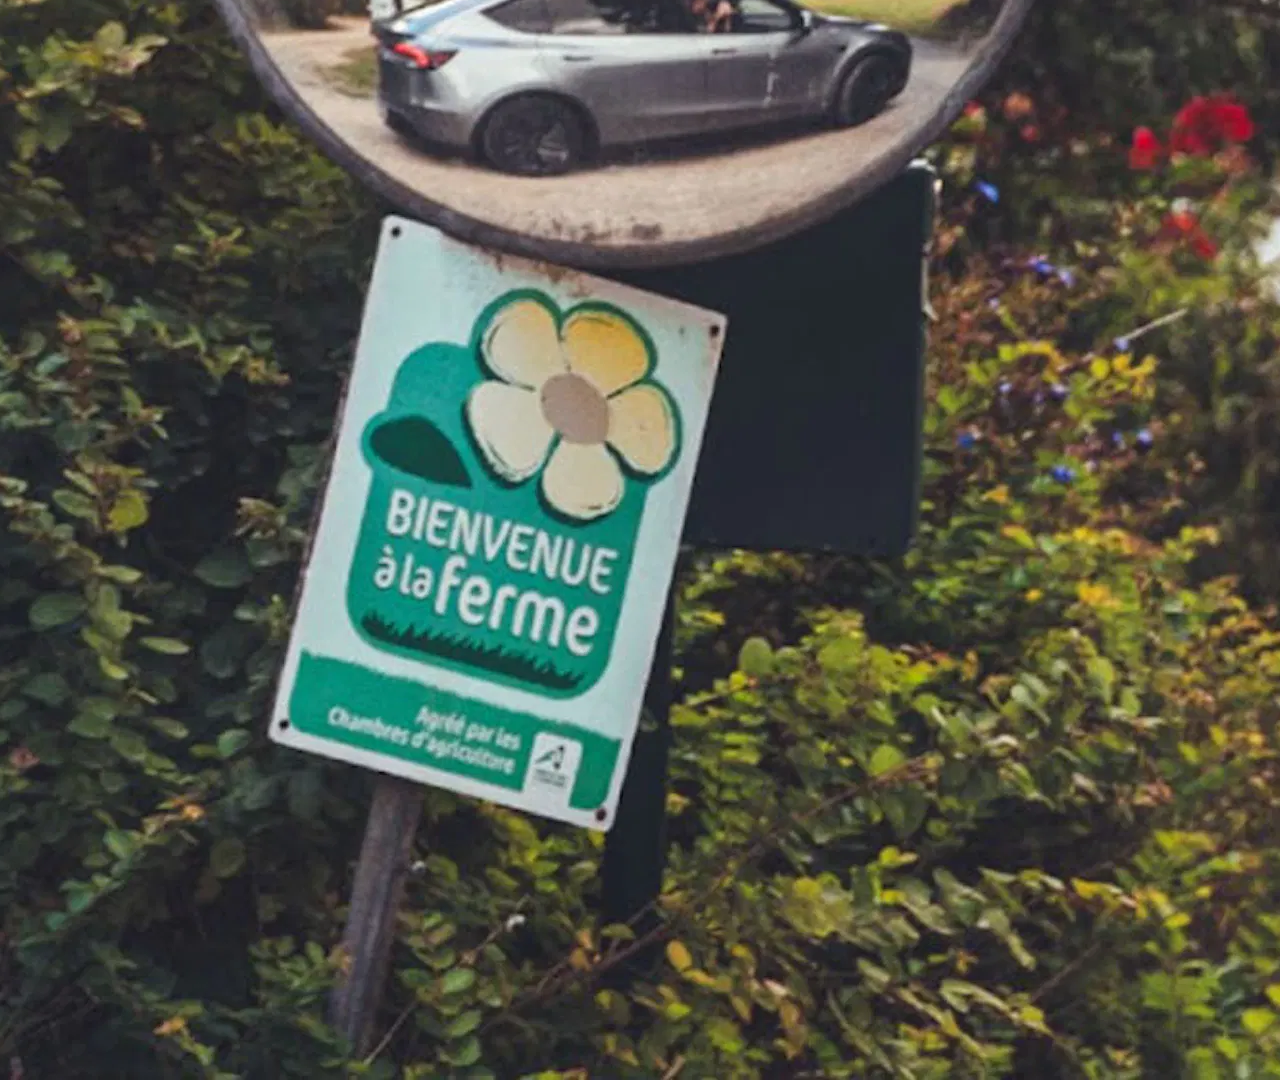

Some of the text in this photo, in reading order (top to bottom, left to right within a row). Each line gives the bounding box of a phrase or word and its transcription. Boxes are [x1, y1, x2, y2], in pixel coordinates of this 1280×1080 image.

[388, 490, 619, 594] BIENVENUE
[375, 546, 599, 657] à la ferme
